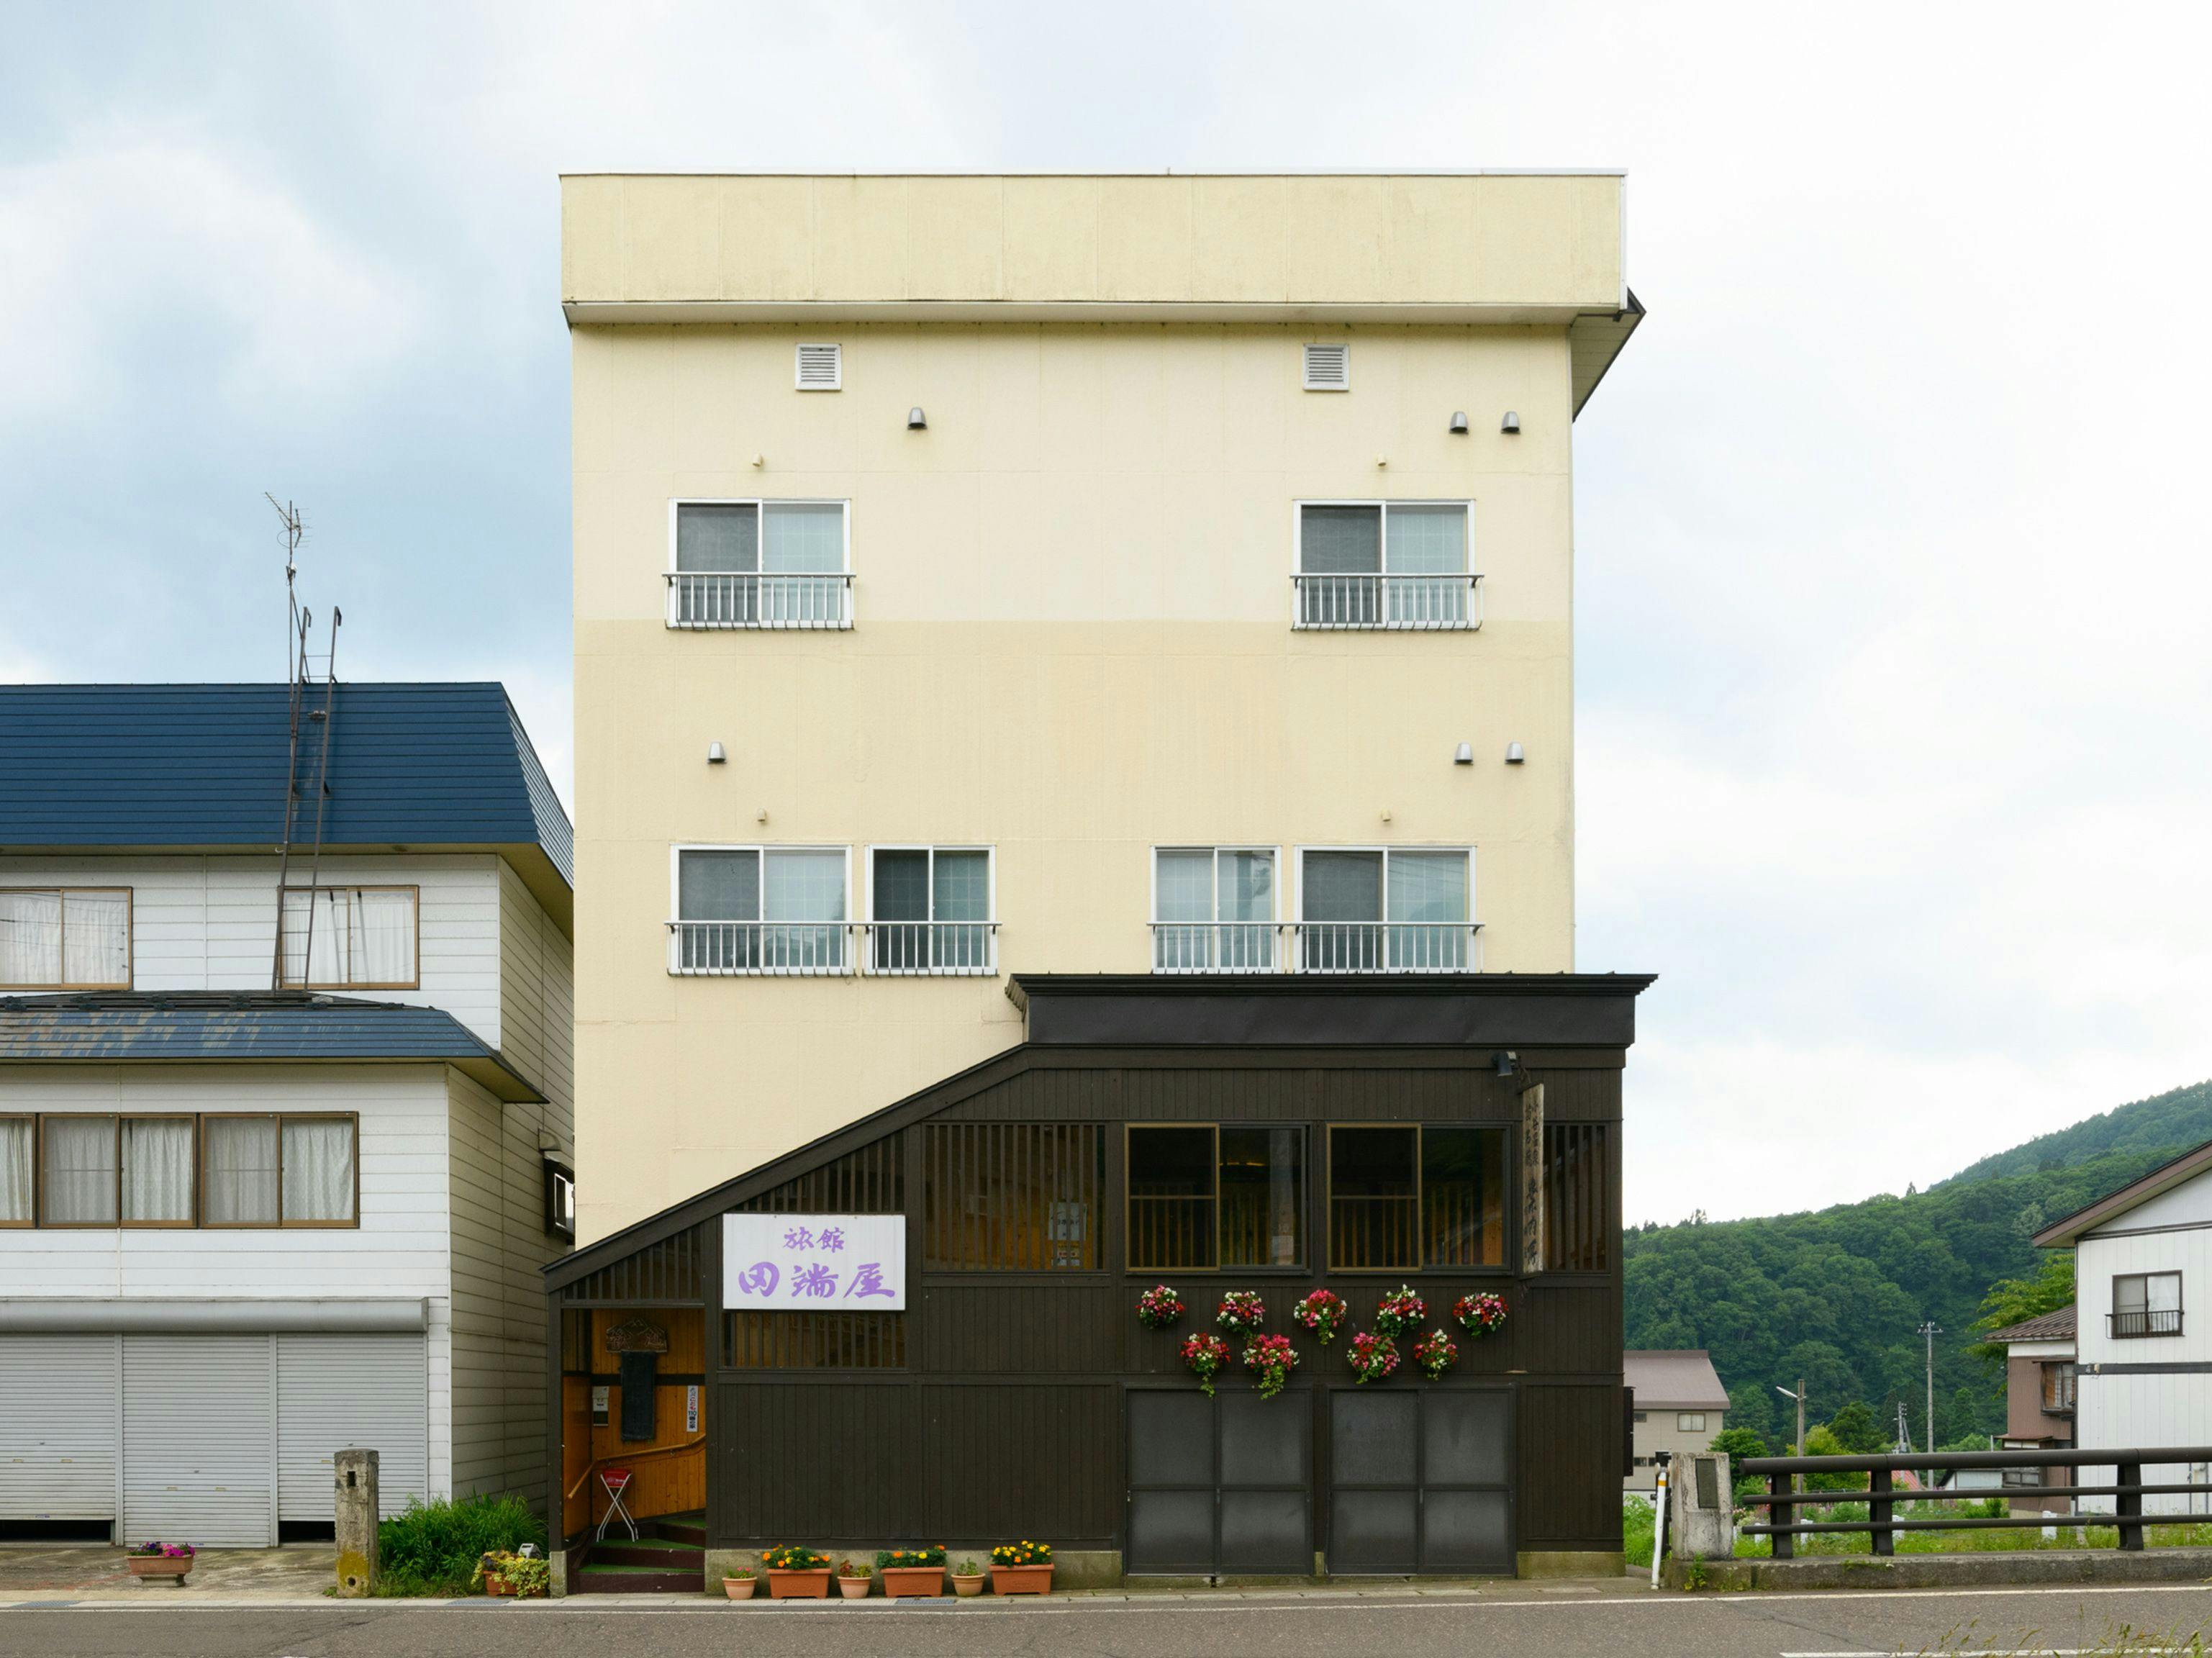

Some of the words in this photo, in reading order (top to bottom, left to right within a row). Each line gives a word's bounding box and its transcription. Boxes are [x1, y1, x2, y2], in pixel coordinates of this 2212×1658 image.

[783, 1226, 846, 1253] 旅館
[738, 1261, 895, 1298] 田端屋
